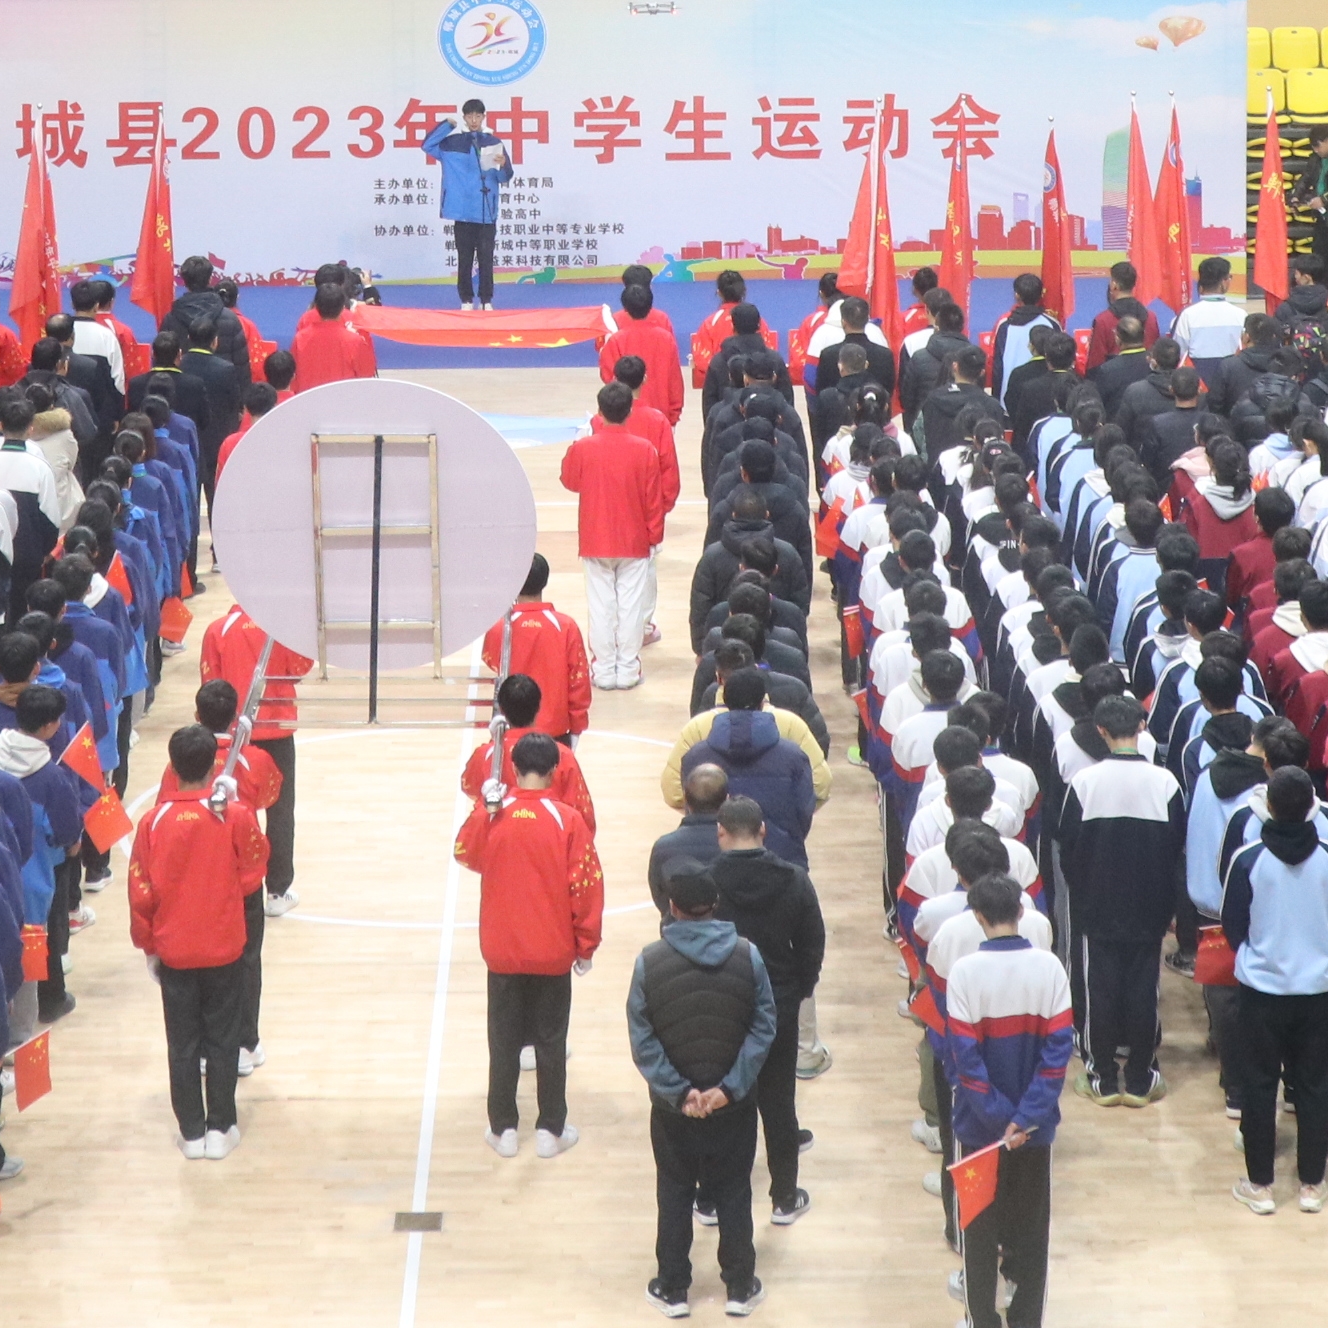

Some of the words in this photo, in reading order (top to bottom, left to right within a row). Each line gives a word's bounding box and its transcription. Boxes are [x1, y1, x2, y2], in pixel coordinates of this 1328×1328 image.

[521, 618, 542, 628] CHINA
[176, 809, 200, 821] CHINA
[512, 808, 537, 820] CHINA
